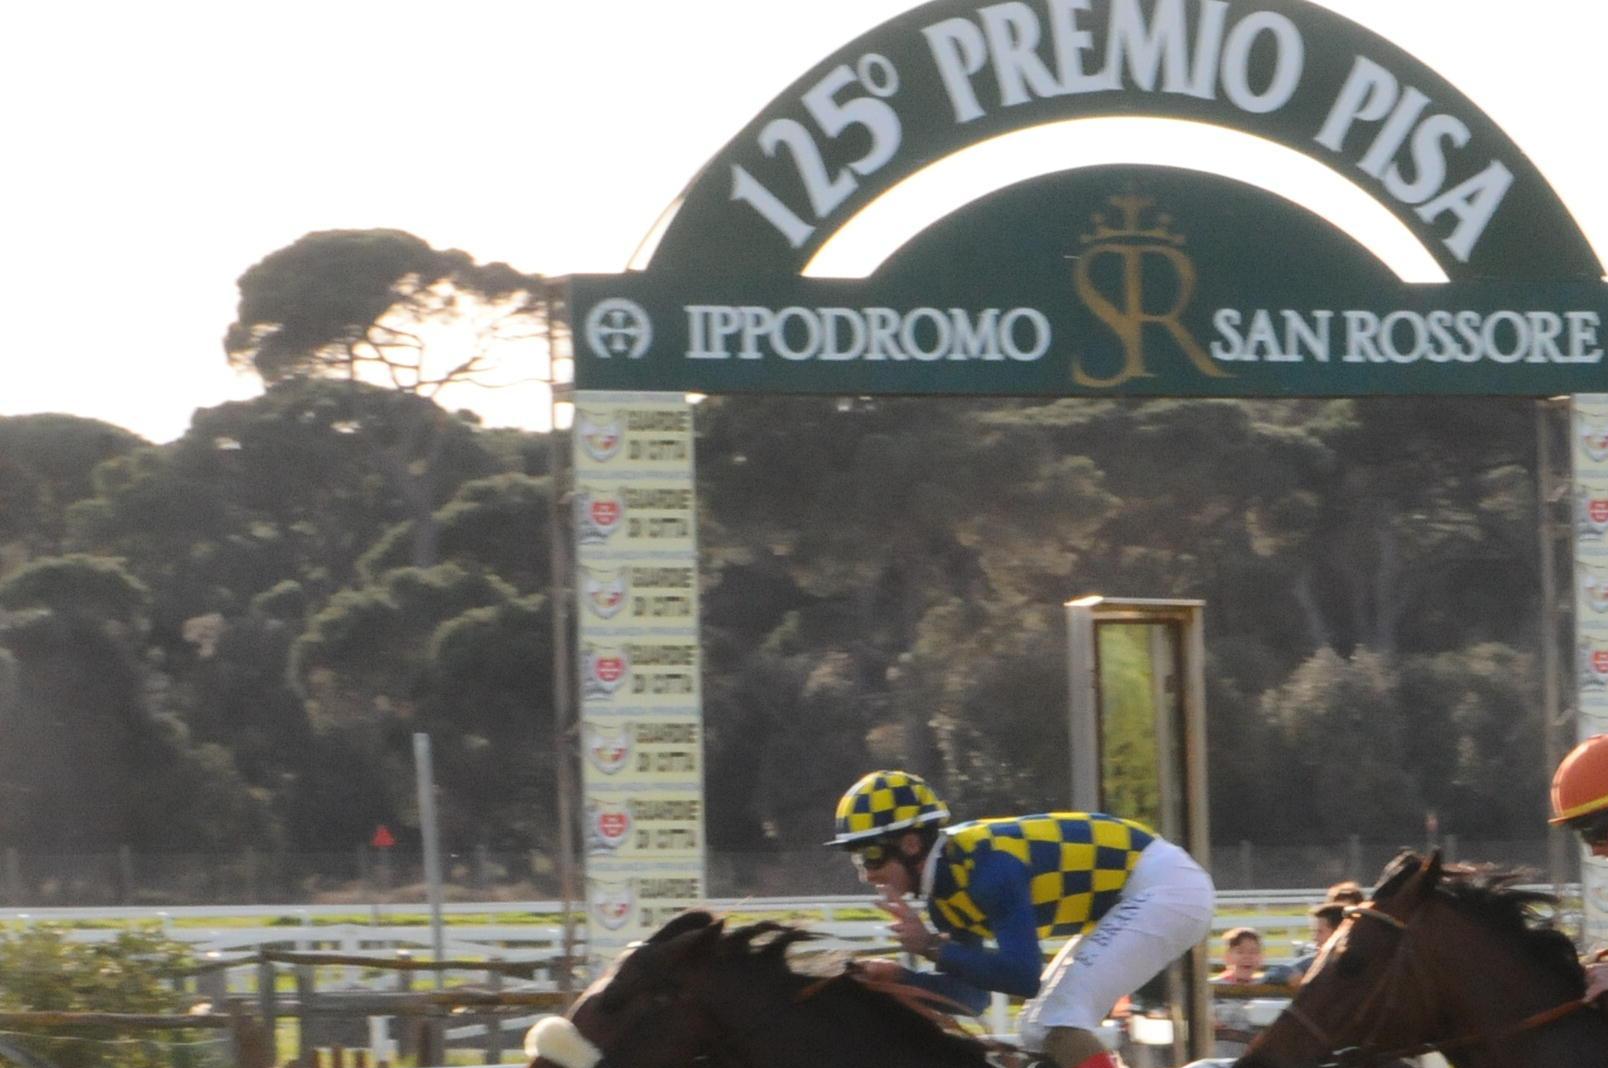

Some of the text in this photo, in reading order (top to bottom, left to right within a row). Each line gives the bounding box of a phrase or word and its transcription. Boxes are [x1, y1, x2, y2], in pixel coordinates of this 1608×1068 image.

[921, 0, 1304, 124] PREMIO
[1315, 55, 1514, 262] PISA
[684, 304, 1603, 364] IPPODROMO SAN ROSSORE
